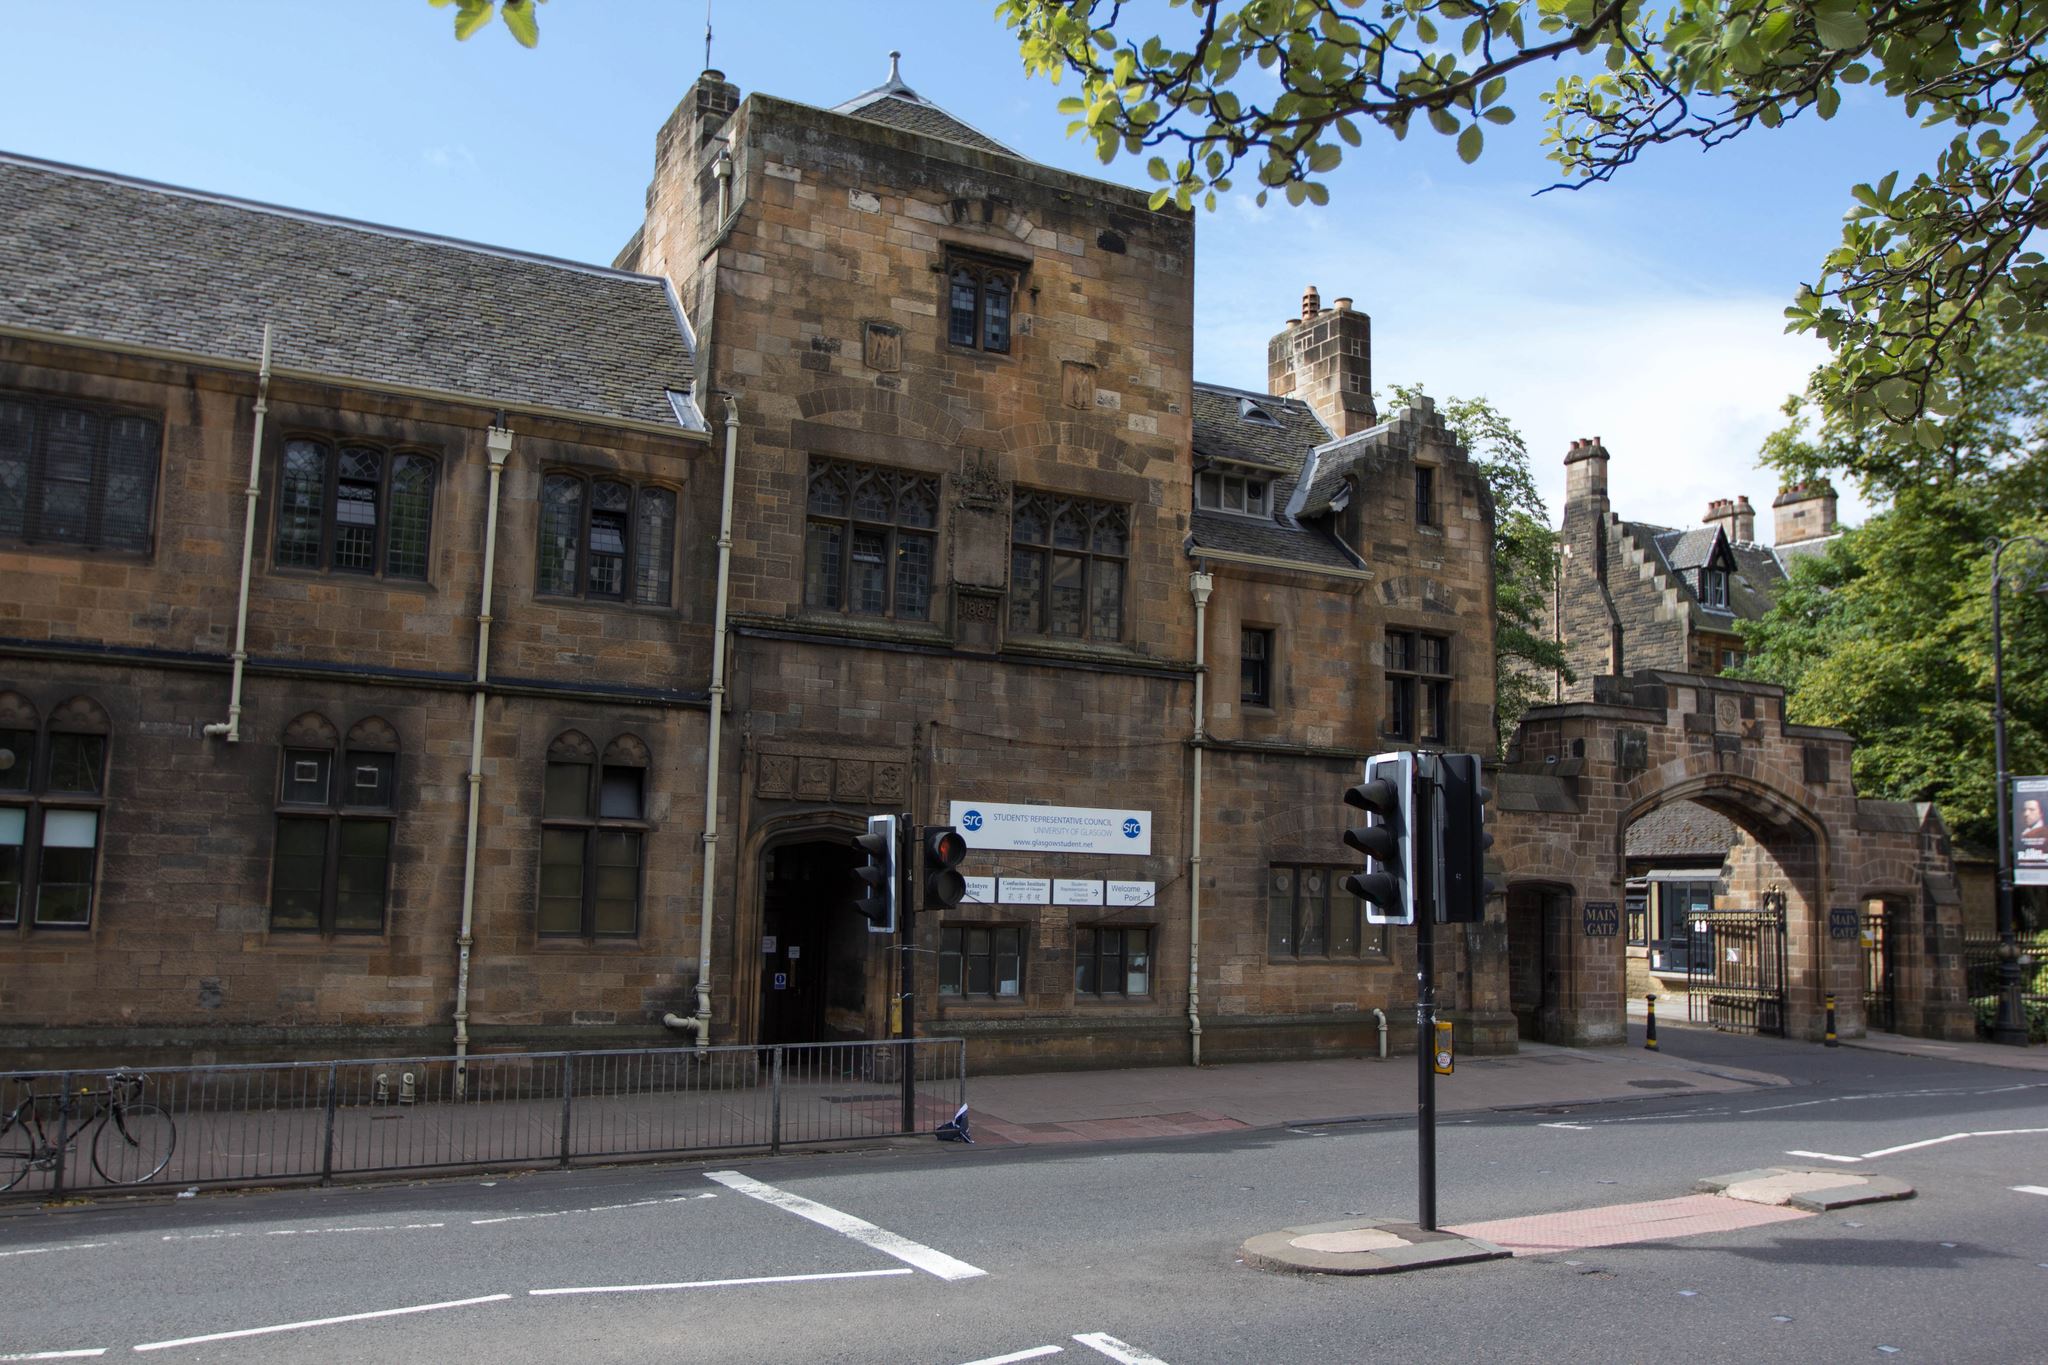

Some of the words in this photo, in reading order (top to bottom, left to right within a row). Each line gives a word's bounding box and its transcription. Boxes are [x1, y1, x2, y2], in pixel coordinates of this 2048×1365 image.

[963, 815, 983, 827] src
[993, 813, 1029, 823] STUDENTS'
[1030, 815, 1083, 825] REPRESENTATIVE
[1084, 818, 1112, 827] COUNCIL
[1033, 826, 1069, 836] UNIVERSITY
[1070, 827, 1079, 836] OF
[1080, 828, 1112, 837] GLASGOW
[1123, 822, 1140, 834] src
[1013, 838, 1093, 849] www.glasgowstudent.net
[1111, 884, 1141, 893] Welcome
[1124, 893, 1141, 902] Point
[1586, 909, 1616, 921] MAIN
[1831, 914, 1856, 926] MAIN
[1586, 922, 1616, 936] GATE
[1832, 927, 1857, 938] GATE
